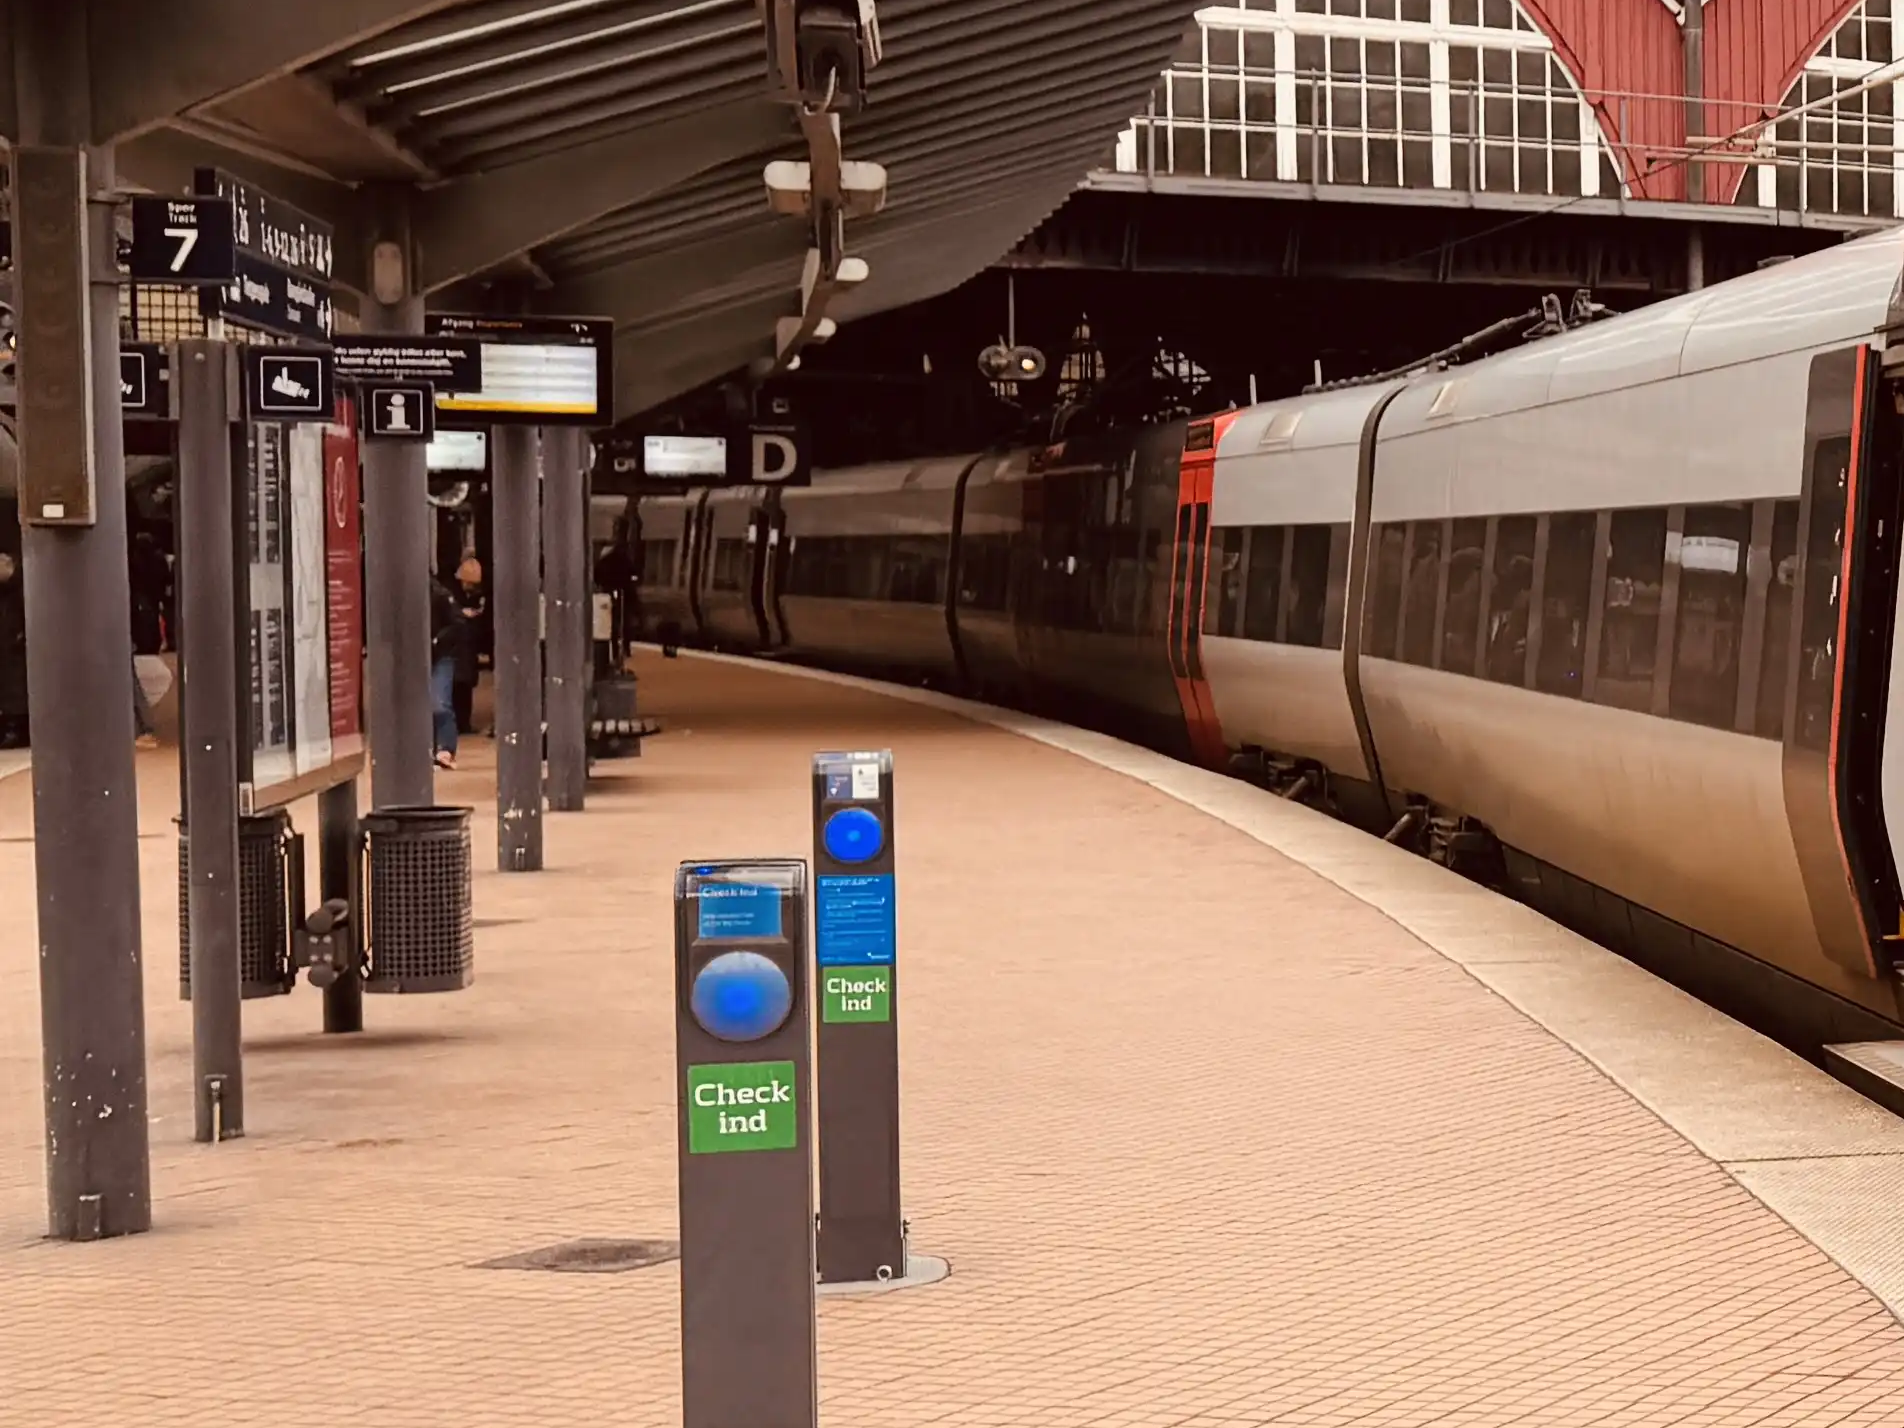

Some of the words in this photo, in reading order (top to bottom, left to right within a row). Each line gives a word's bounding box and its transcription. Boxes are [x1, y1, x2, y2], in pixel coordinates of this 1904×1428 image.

[163, 227, 199, 272] 7
[752, 433, 798, 482] D
[826, 977, 887, 994] Check
[694, 1080, 791, 1107] Check
[719, 1109, 768, 1134] ind
